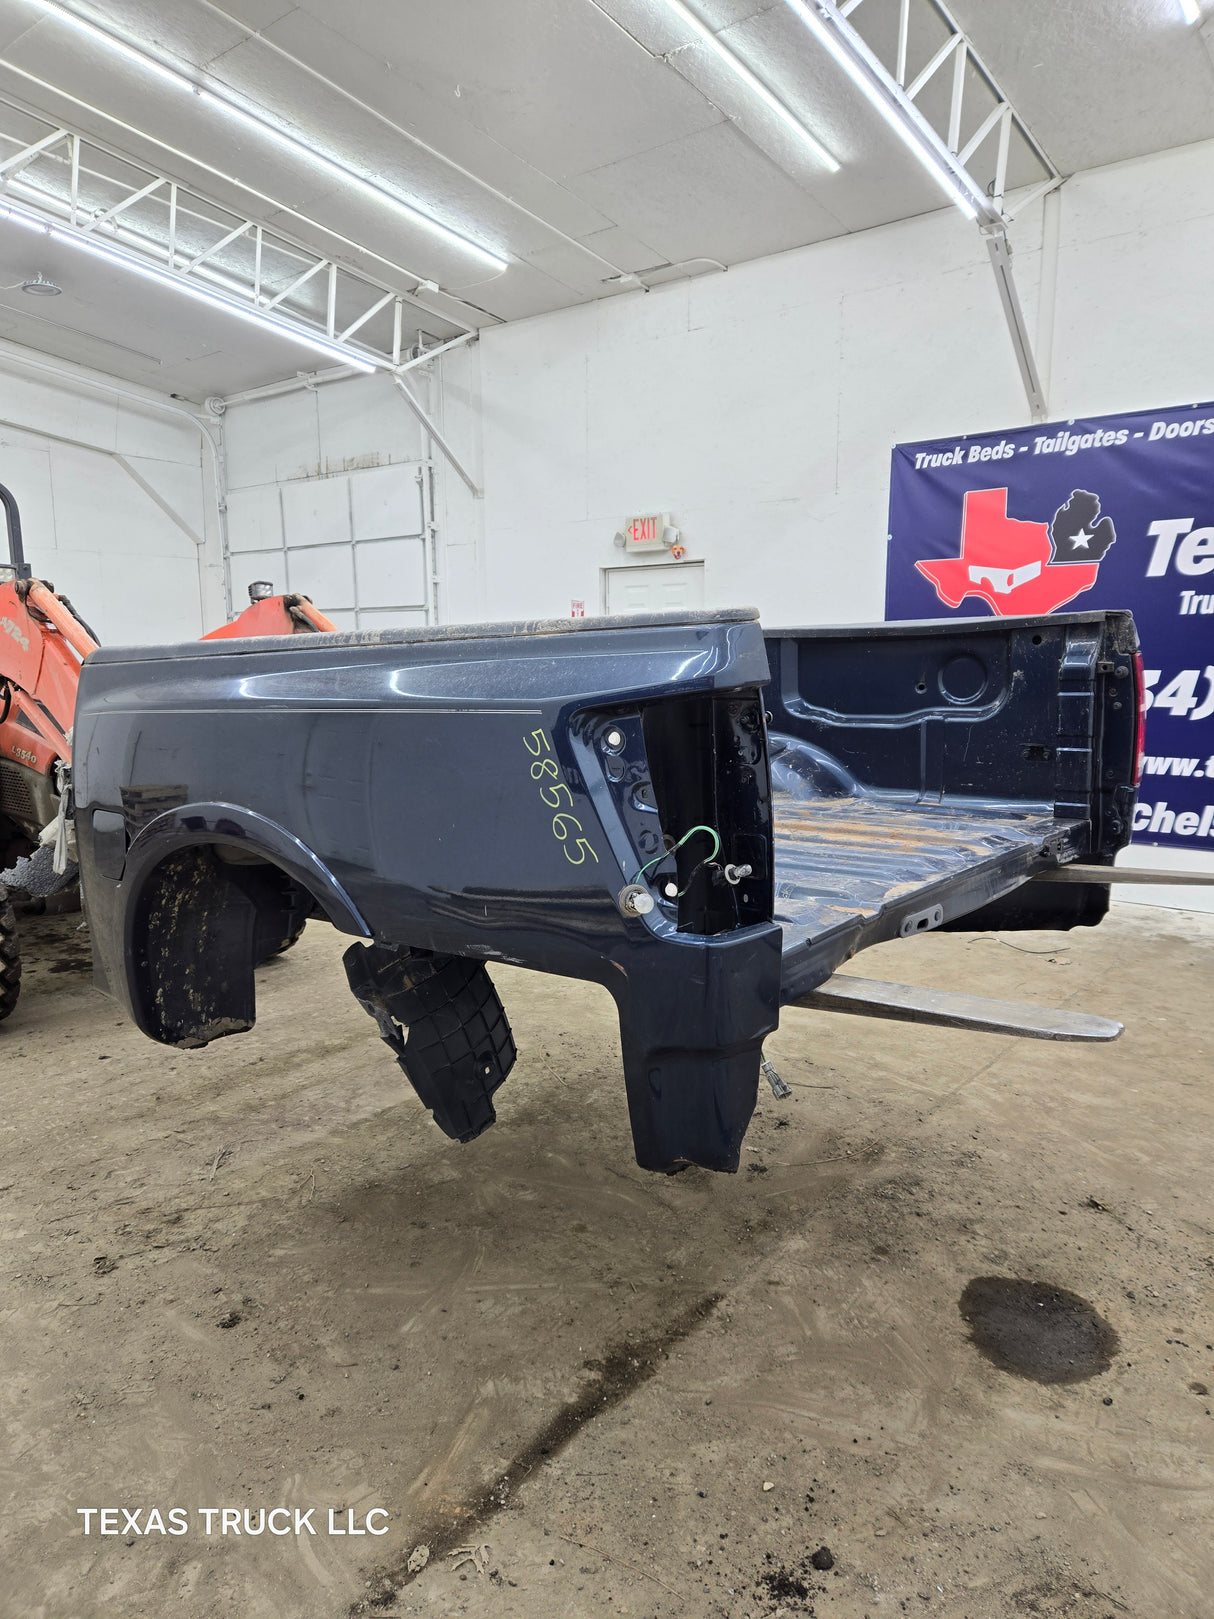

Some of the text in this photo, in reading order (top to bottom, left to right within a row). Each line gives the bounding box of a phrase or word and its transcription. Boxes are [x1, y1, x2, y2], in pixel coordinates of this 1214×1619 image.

[915, 446, 963, 469] Truck
[967, 441, 1015, 463] Beds
[1033, 429, 1129, 456] Tailgates
[1148, 417, 1214, 442] Doors
[633, 517, 657, 541] EXIT
[11, 745, 37, 763] L3540
[523, 728, 599, 865] 58565
[1132, 802, 1214, 837] Chel
